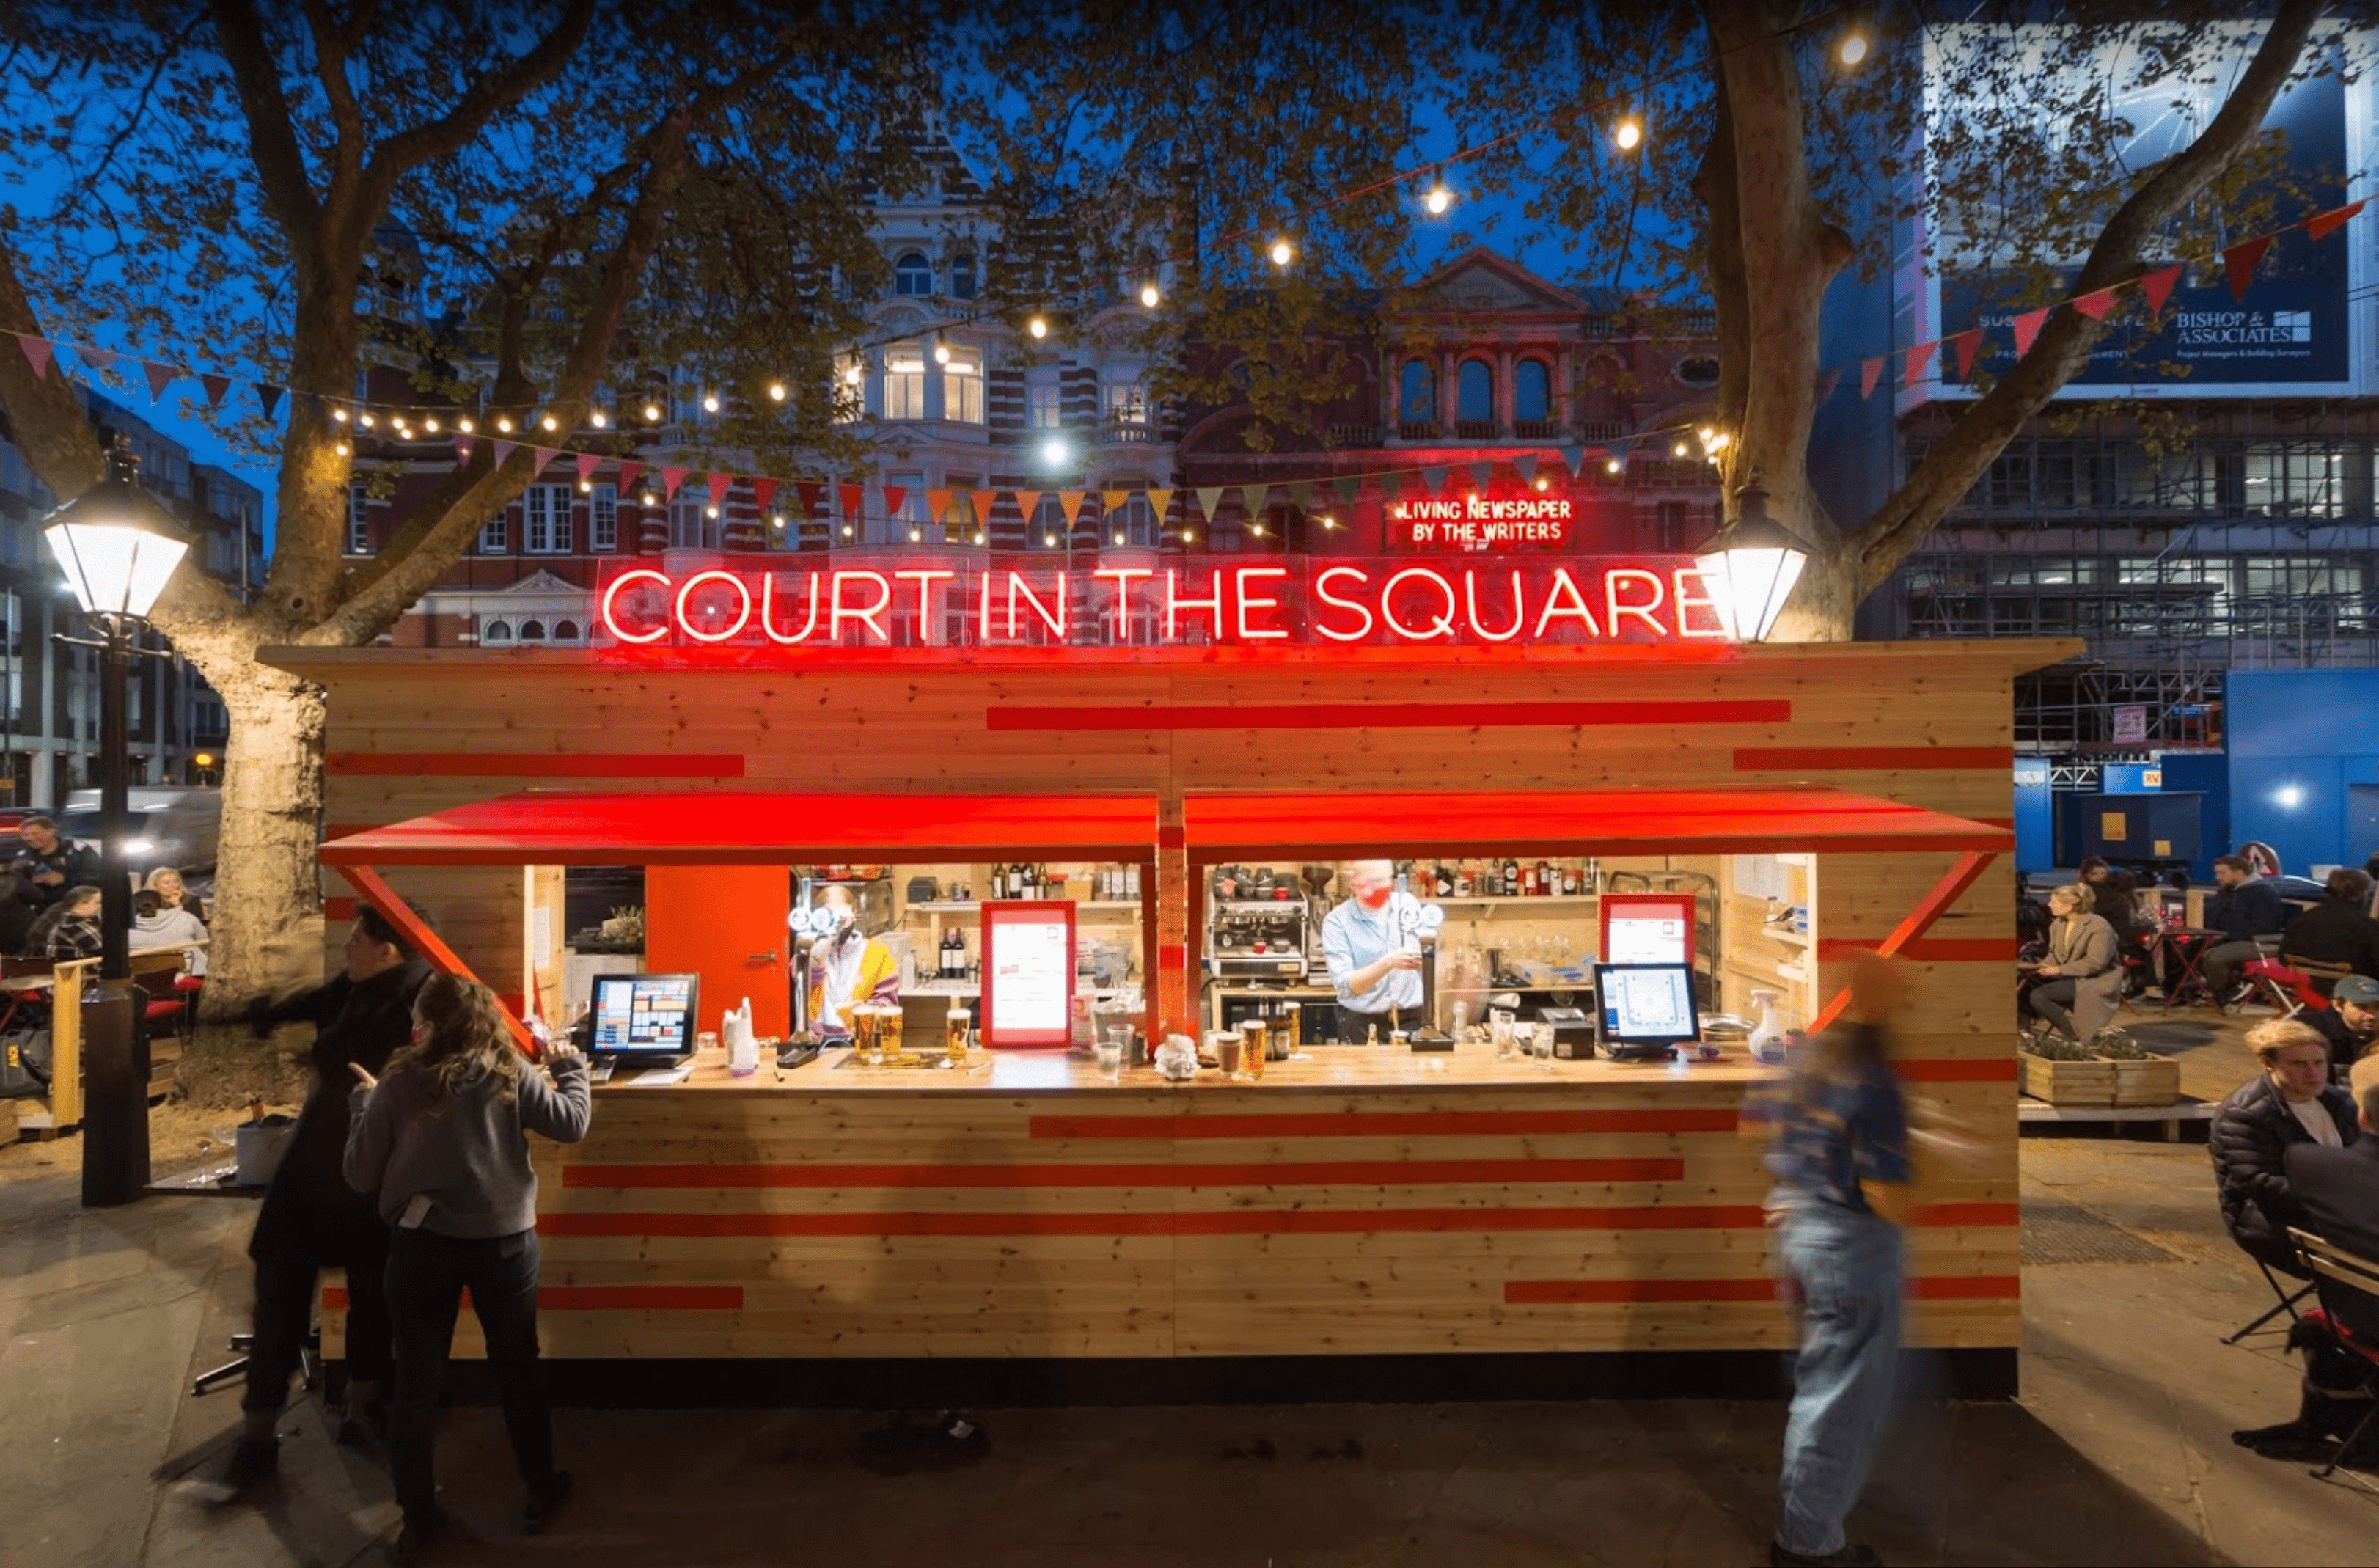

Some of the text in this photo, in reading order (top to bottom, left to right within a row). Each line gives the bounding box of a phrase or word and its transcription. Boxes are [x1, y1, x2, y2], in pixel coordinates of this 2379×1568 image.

[2177, 310, 2265, 328] BISHOP &
[2177, 328, 2291, 344] ASSOCIATES
[2247, 349, 2275, 358] Building
[1403, 500, 1571, 519] LIVING NEWSPAPER
[1412, 521, 1561, 541] BY THE WRITERS
[601, 566, 1729, 645] COURT IN THE SQUARE
